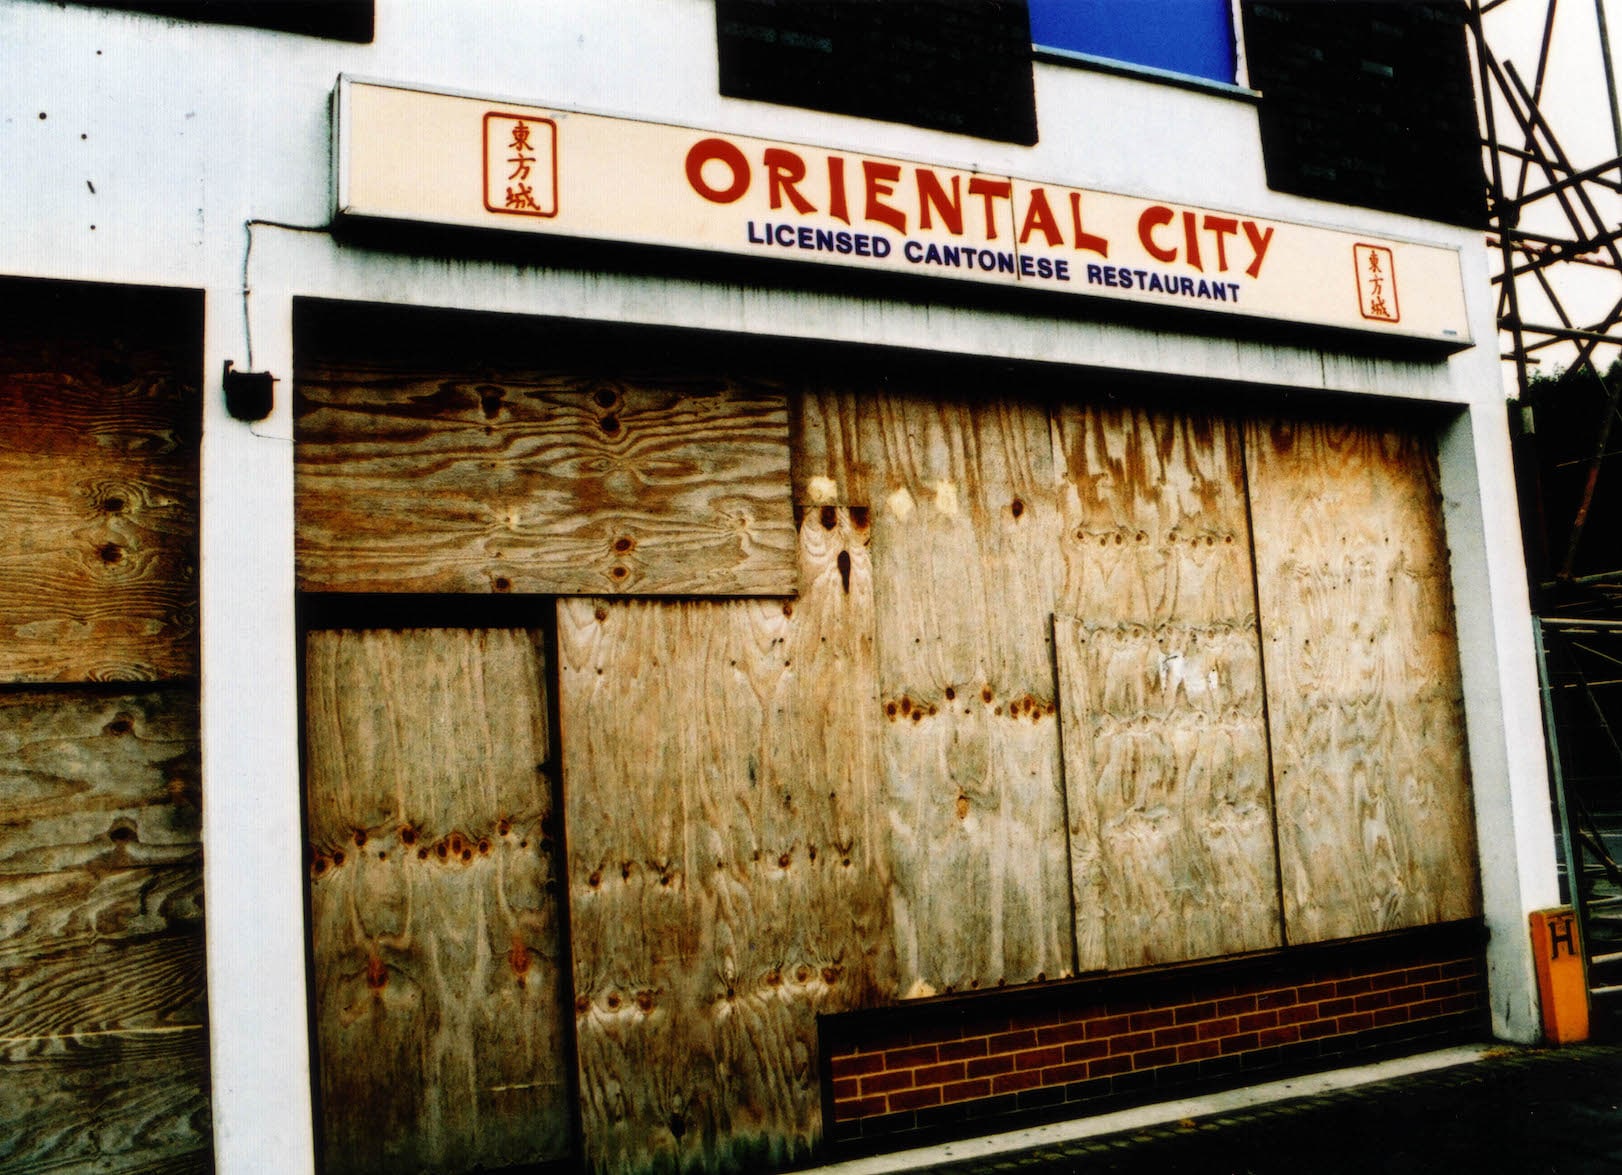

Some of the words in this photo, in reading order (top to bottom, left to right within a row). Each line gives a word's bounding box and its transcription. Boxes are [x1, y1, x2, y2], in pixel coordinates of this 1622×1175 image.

[506, 120, 541, 211] 東方城
[685, 138, 1108, 258] ORIENTAL
[1138, 206, 1274, 279] CITY
[748, 221, 891, 258] LICENSED
[904, 240, 1071, 281] CANTONESE
[1087, 263, 1240, 303] RESTAURANT
[1368, 250, 1391, 318] 東方城
[1549, 919, 1577, 960] H
